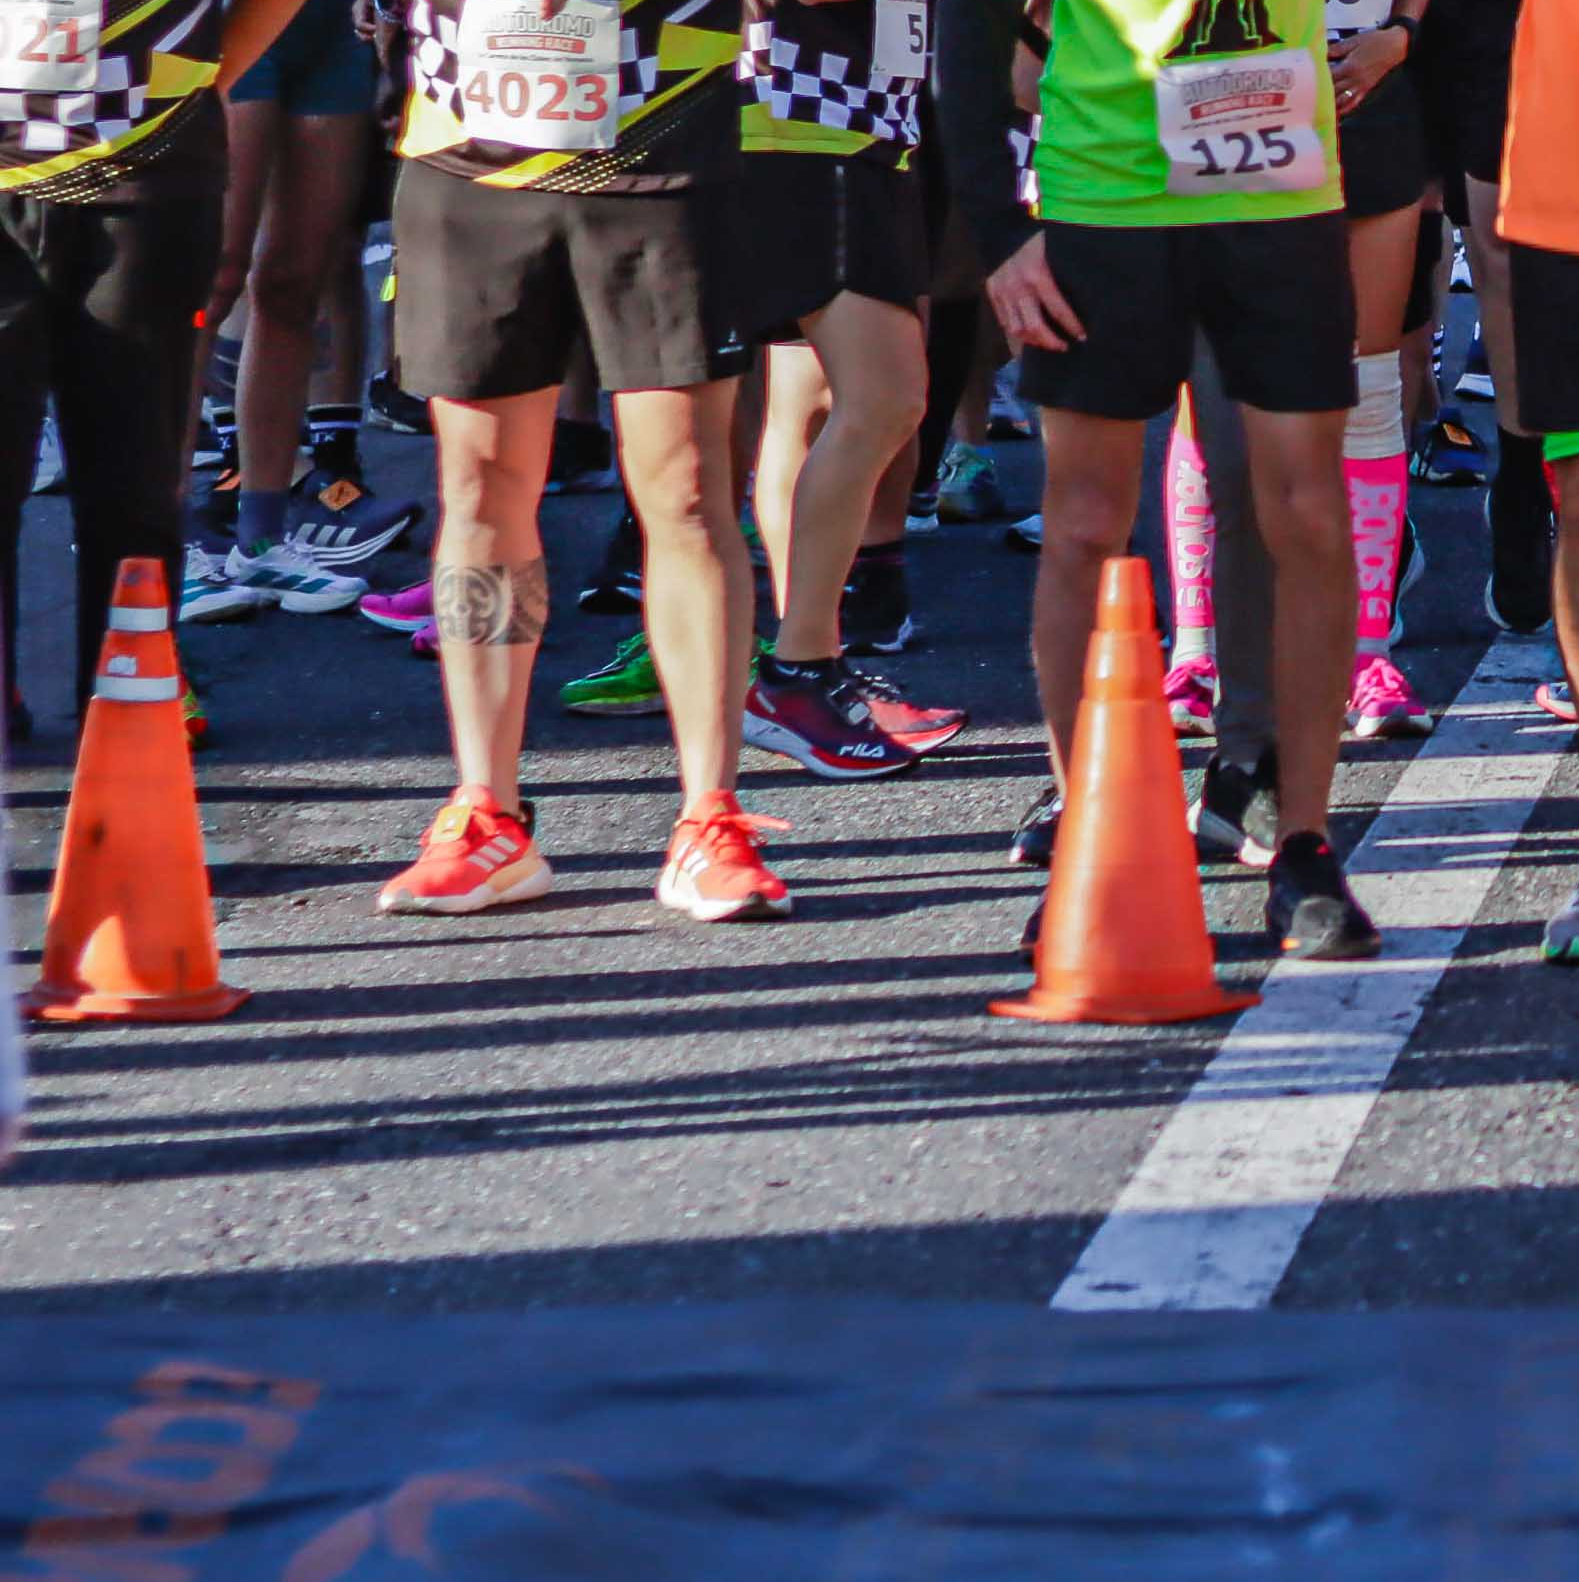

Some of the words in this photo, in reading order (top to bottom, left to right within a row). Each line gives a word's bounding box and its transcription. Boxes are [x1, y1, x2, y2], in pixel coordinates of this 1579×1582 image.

[465, 70, 609, 122] 4023
[1190, 125, 1296, 176] 125
[838, 742, 885, 758] FILA
